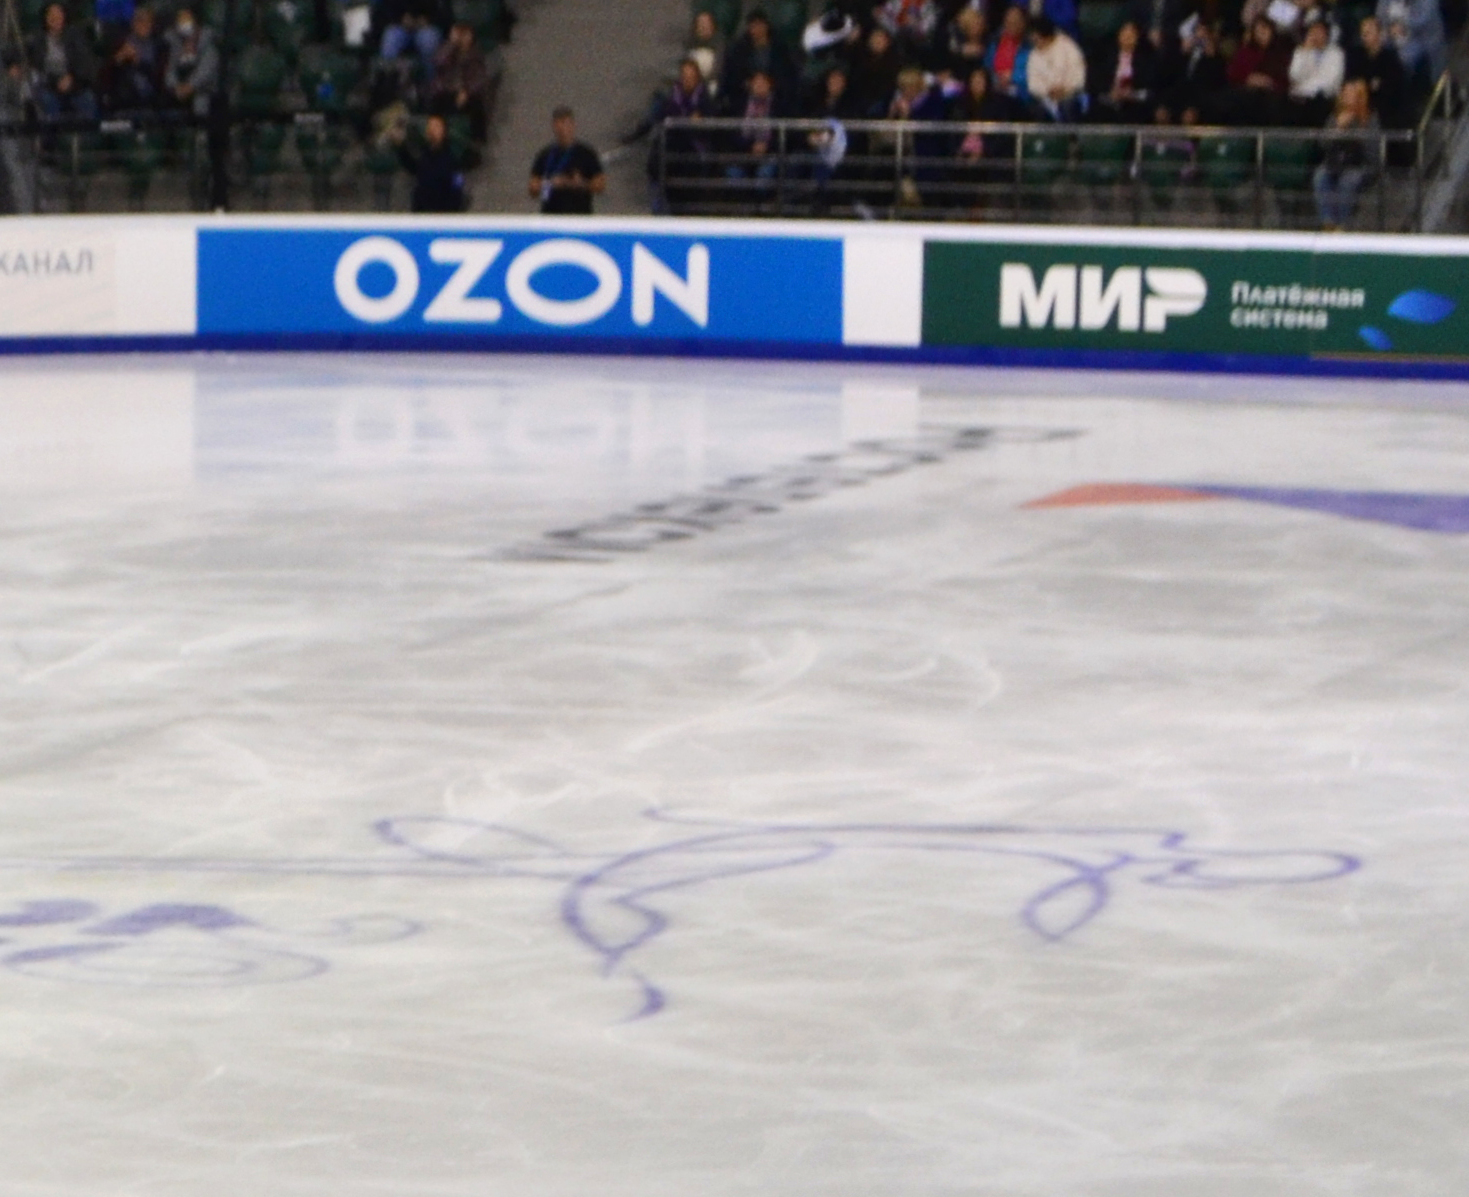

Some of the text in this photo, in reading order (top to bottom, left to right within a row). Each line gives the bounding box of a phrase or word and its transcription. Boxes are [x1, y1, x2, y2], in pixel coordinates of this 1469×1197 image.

[333, 236, 710, 328] OZON
[999, 262, 1209, 333] МИР
[1231, 280, 1365, 310] Платёжная
[1230, 307, 1329, 330] система
